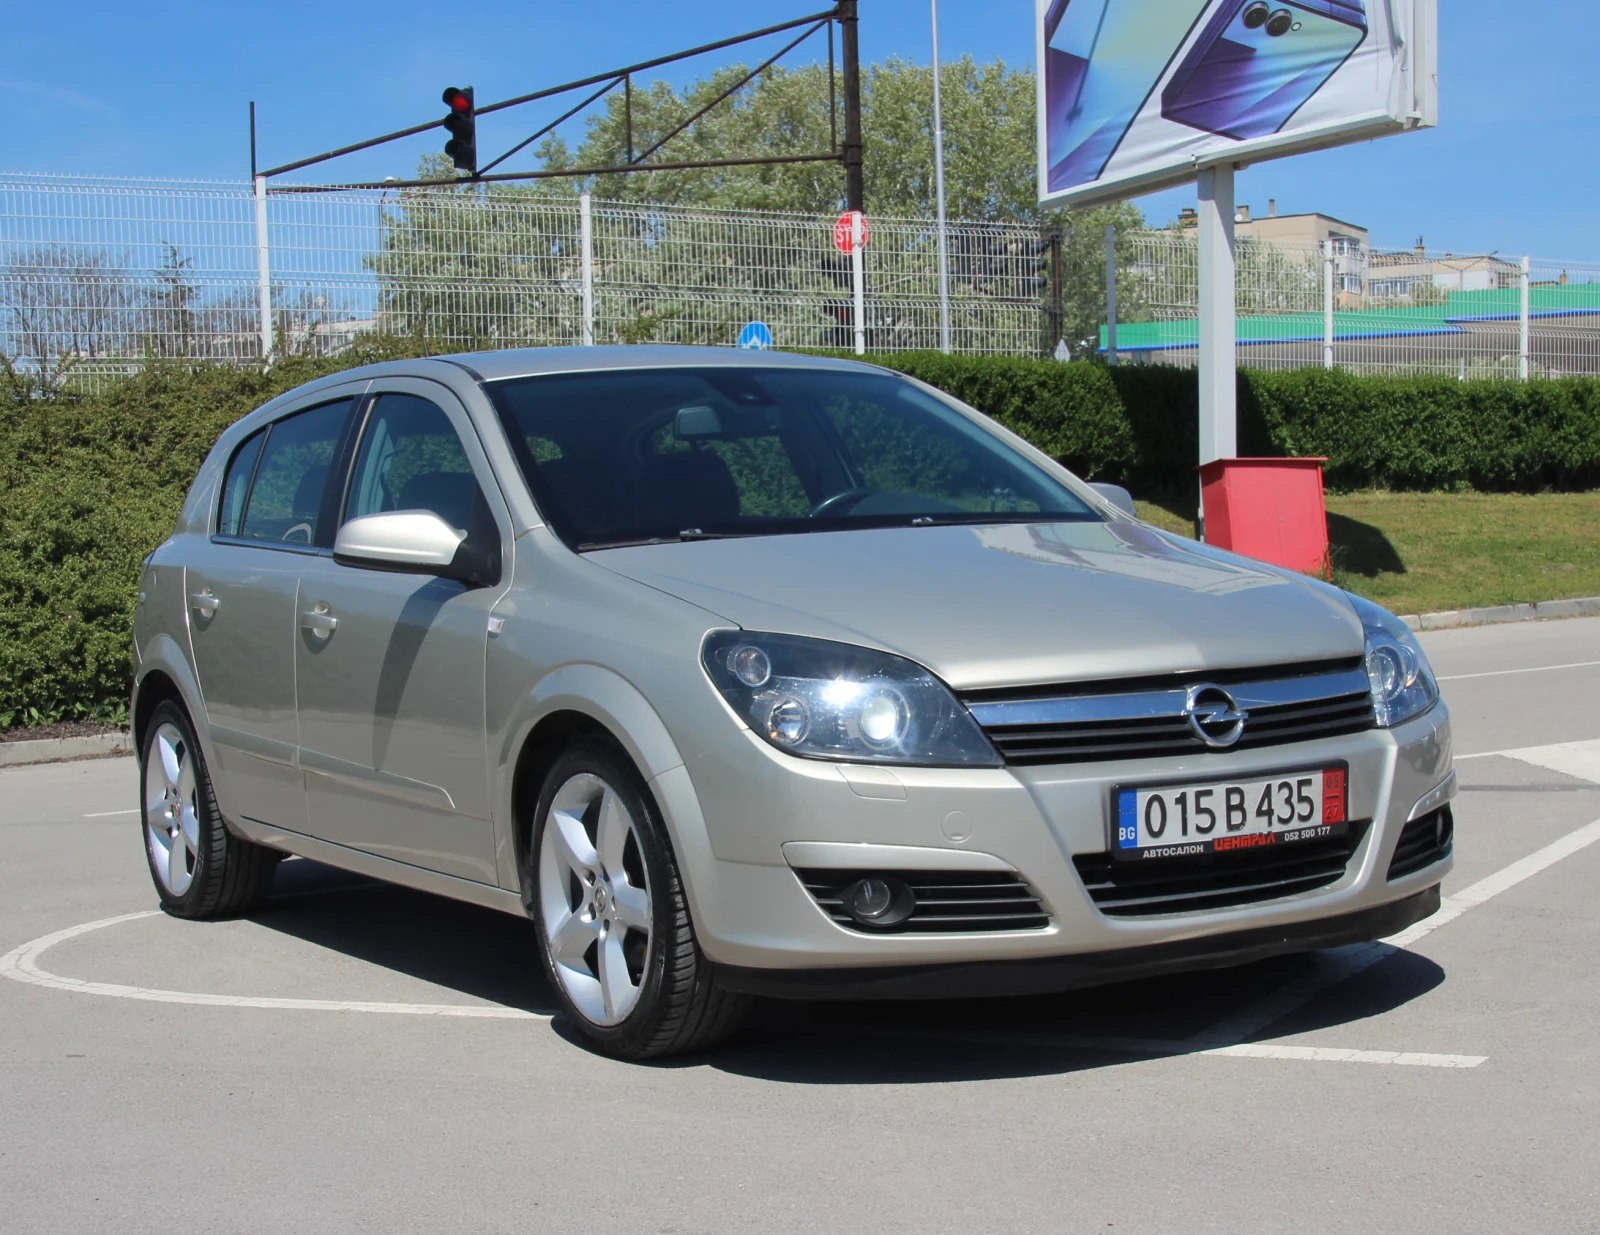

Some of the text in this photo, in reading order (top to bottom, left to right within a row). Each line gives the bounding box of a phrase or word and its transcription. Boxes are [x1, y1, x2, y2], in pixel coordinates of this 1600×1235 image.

[1326, 774, 1340, 789] 05
[1325, 803, 1340, 820] 27
[1118, 826, 1136, 841] BG
[1143, 844, 1204, 858] АВТОСАЛОН
[1284, 831, 1299, 841] 052
[1301, 828, 1315, 839] 500
[1317, 826, 1331, 836] 177
